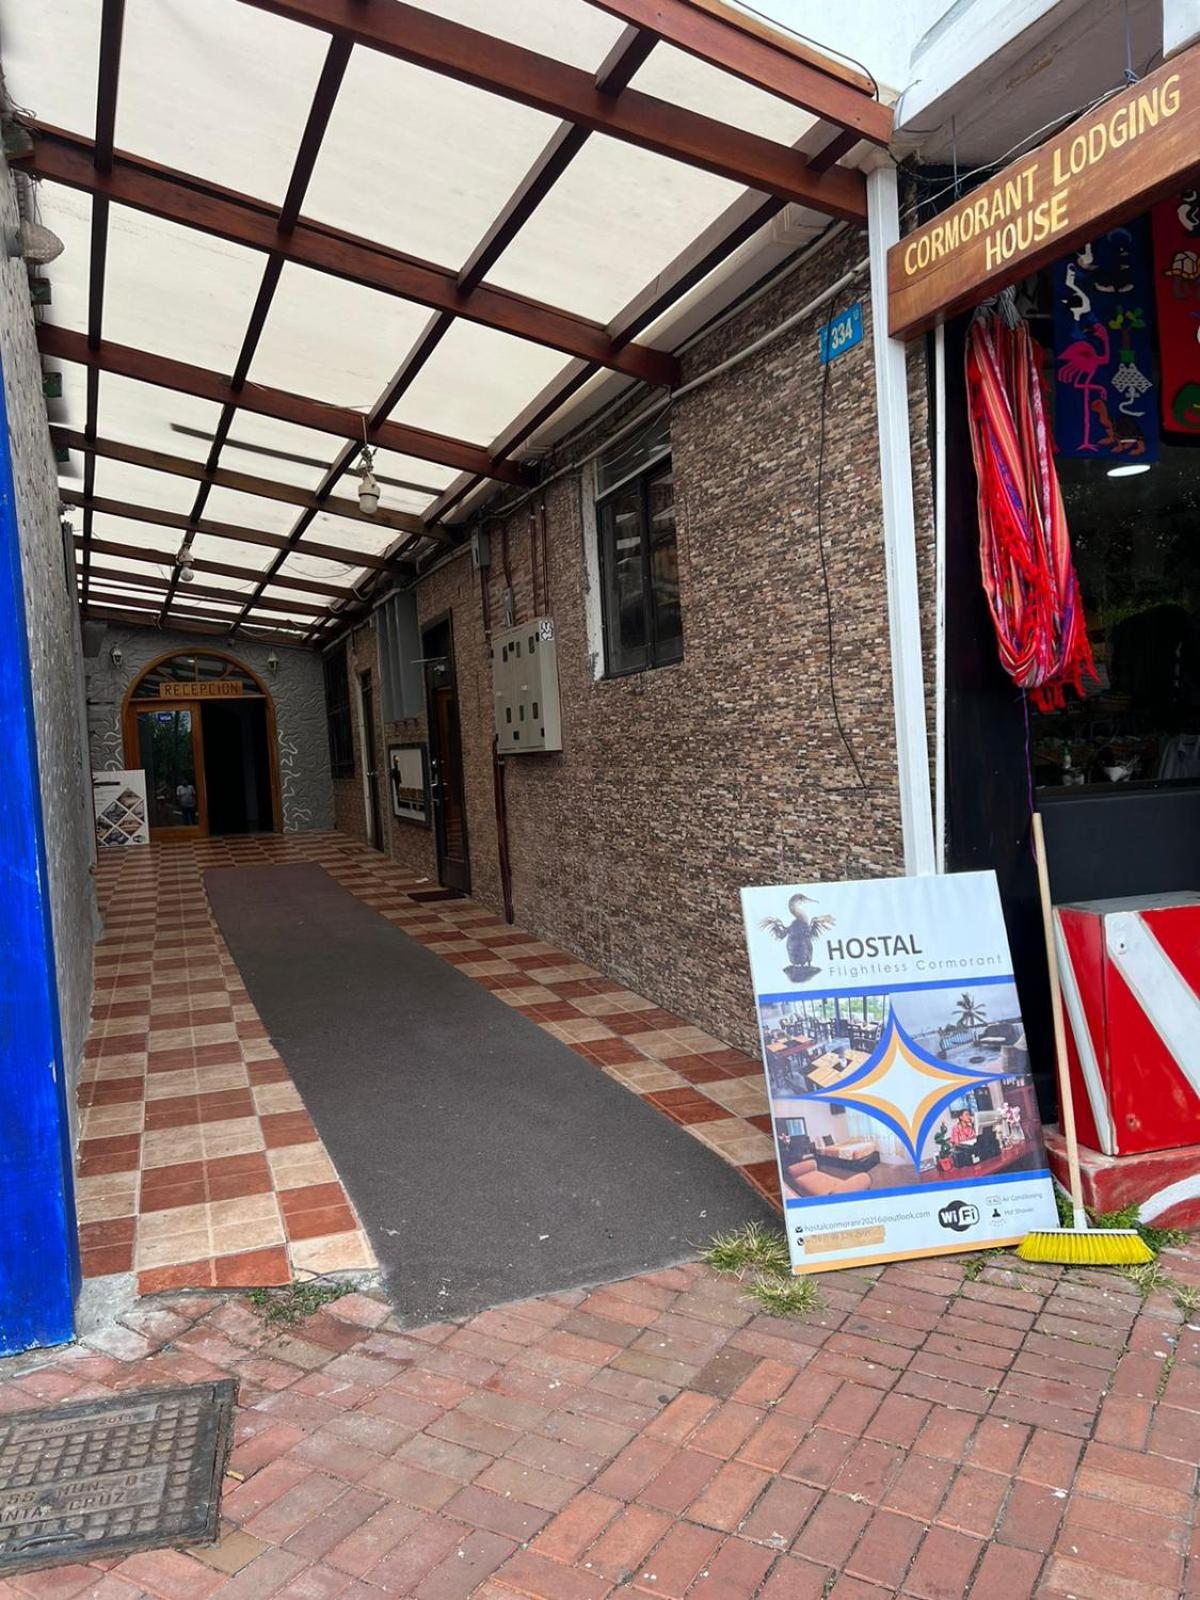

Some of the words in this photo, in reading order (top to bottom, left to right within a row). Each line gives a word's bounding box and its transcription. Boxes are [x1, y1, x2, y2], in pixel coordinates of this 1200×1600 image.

[903, 163, 1038, 277] CORMORANT
[1053, 74, 1181, 187] LODGING
[985, 191, 1069, 271] HOUSE
[831, 317, 853, 350] 334
[164, 682, 239, 697] RECEPCION
[826, 934, 923, 961] HOSTAL
[829, 962, 908, 978] Flightless
[915, 953, 1003, 972] Cormorant
[68, 1491, 126, 1511] CRUZ
